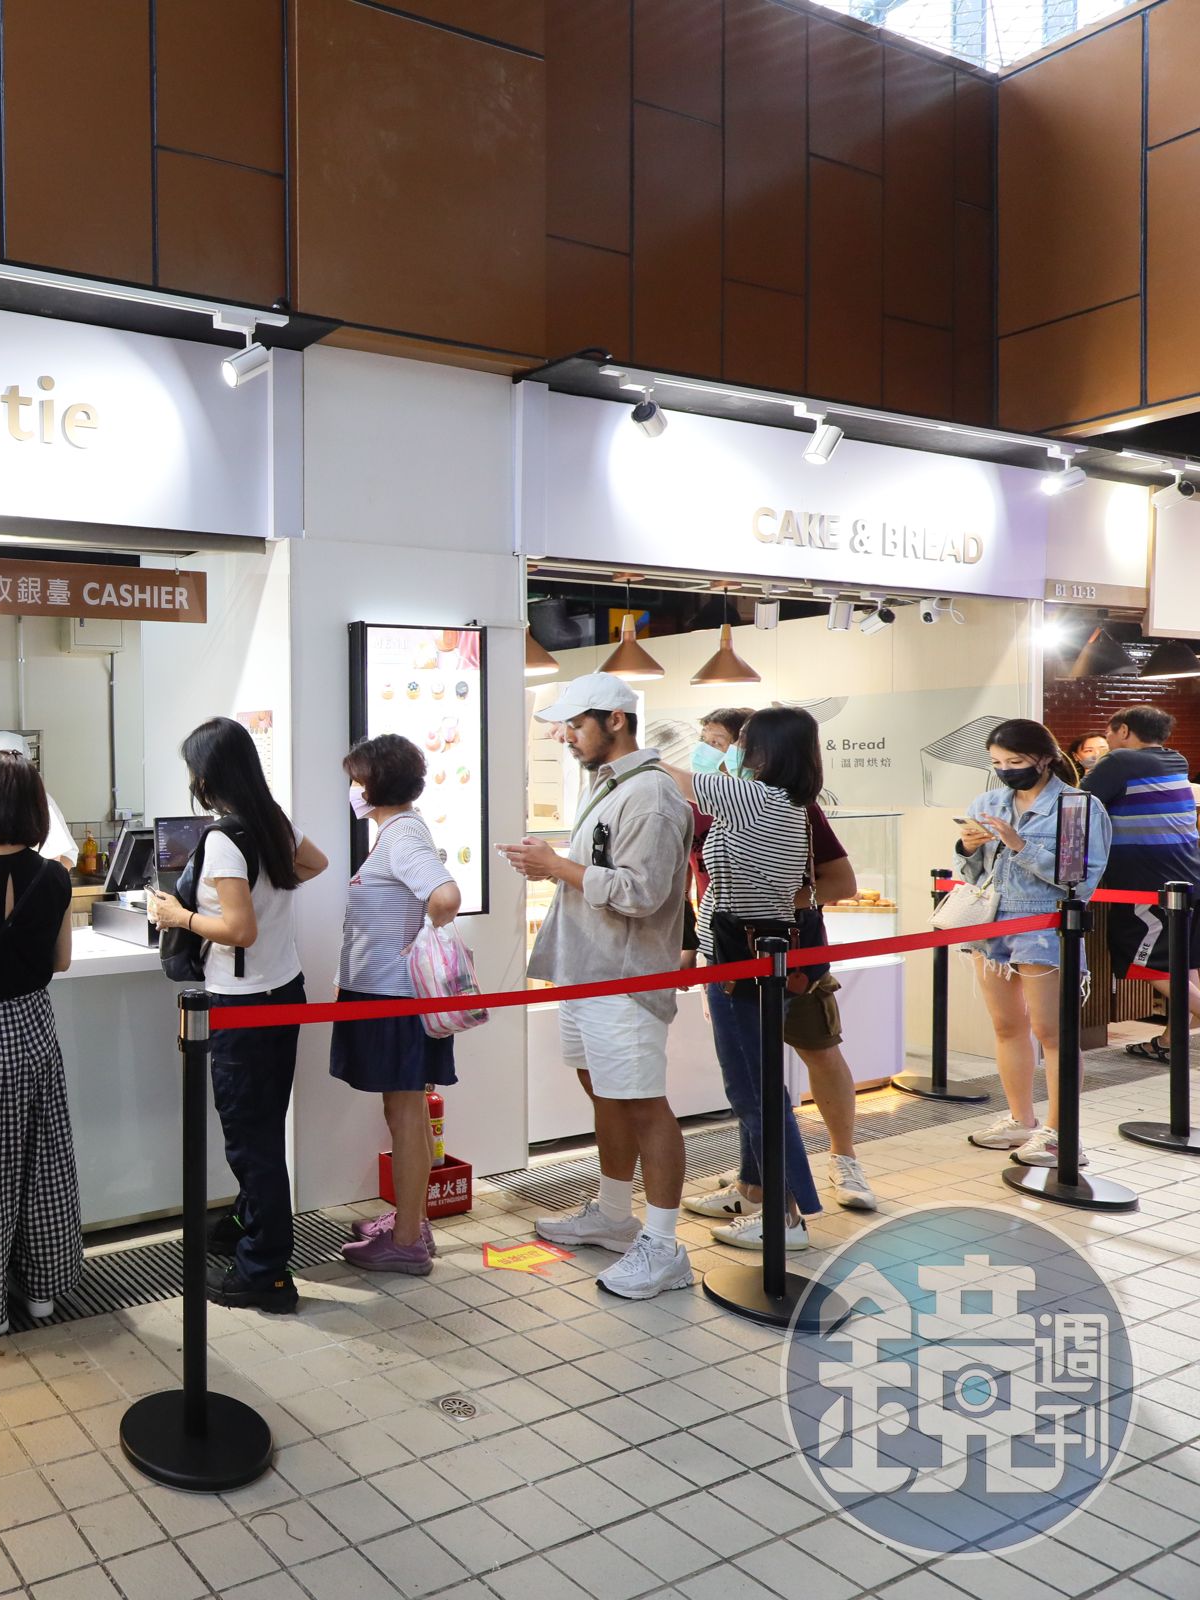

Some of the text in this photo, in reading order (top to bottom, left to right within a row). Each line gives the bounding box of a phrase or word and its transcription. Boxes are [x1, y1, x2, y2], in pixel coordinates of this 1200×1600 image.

[752, 506, 985, 565] CAKE & BREAD
[82, 582, 190, 610] CASHIER
[1055, 583, 1096, 599] B1 11-13
[826, 737, 886, 751] & Bread
[428, 1177, 468, 1200] 滅火器
